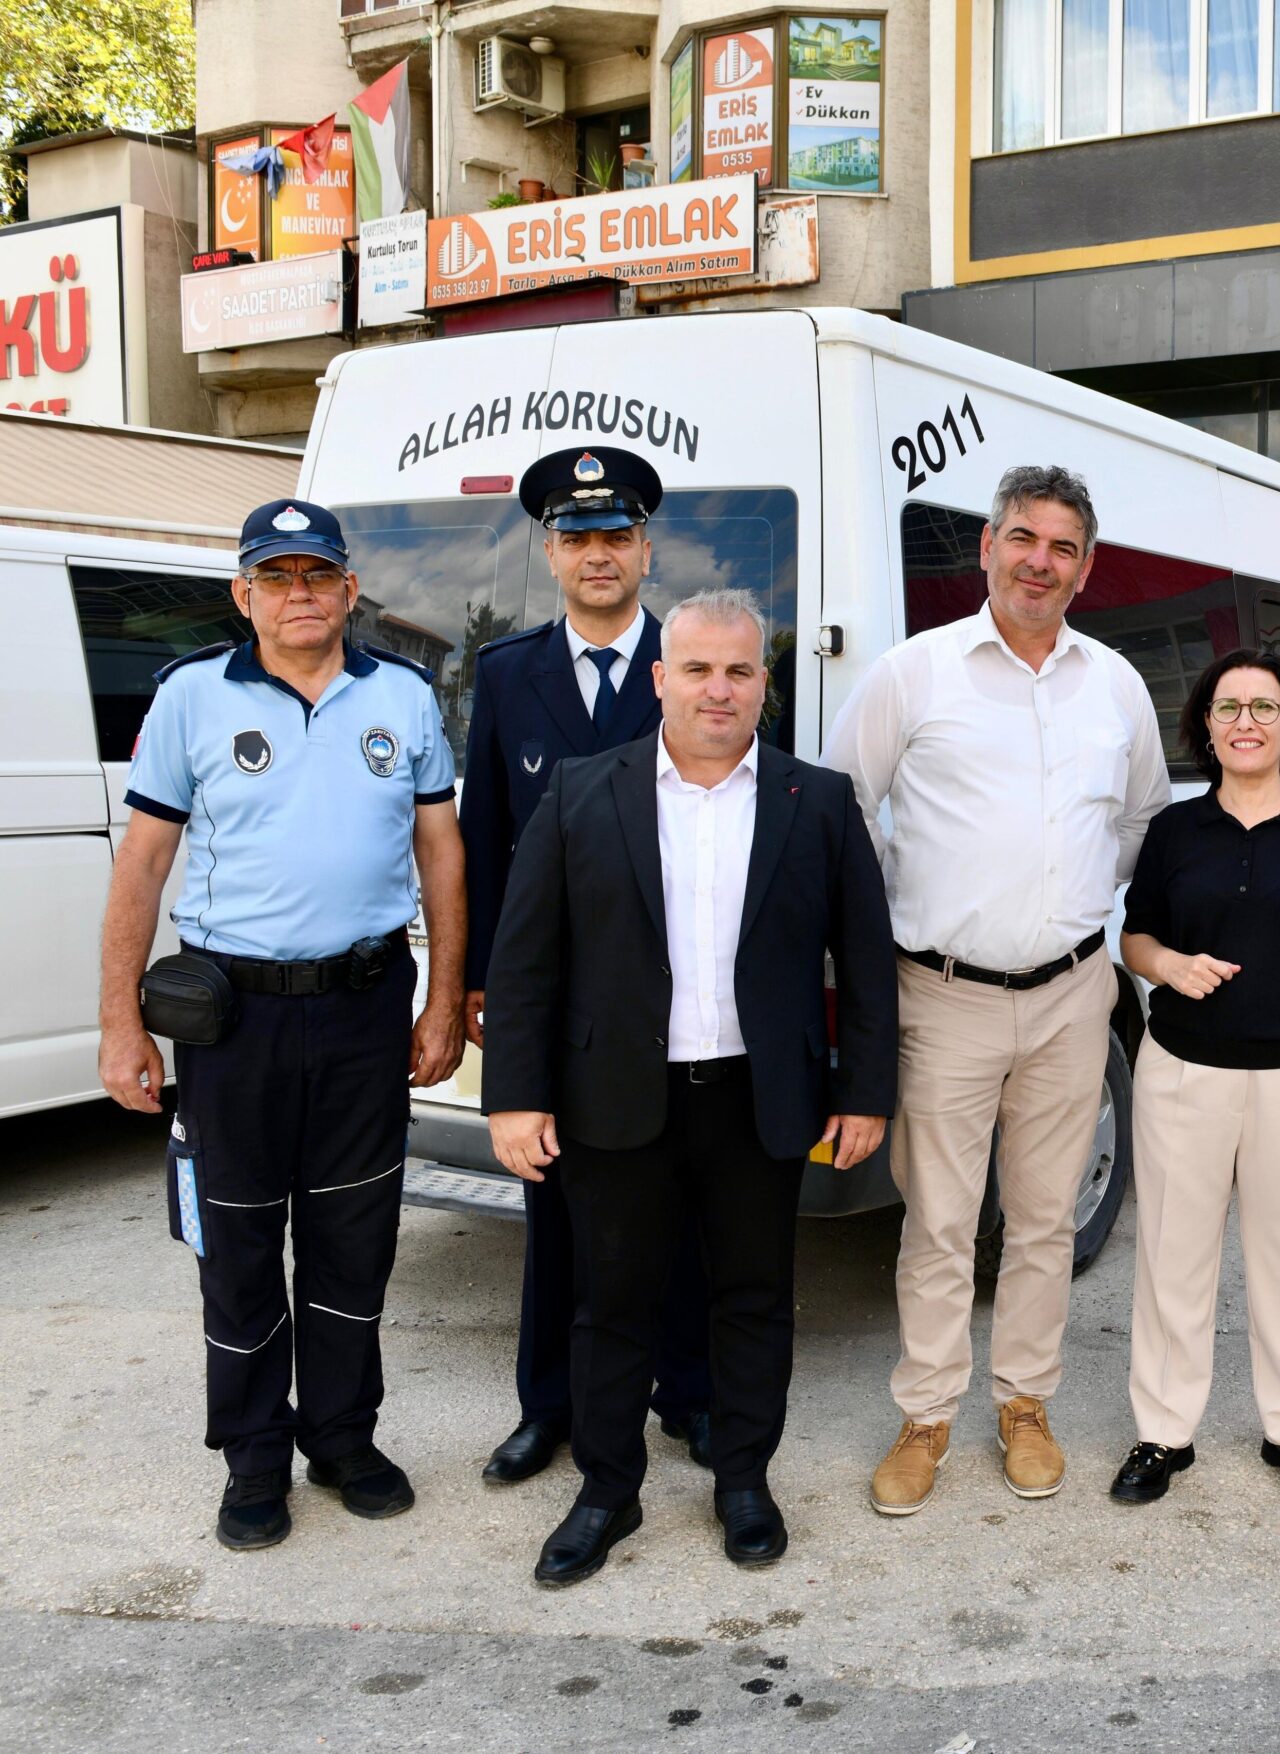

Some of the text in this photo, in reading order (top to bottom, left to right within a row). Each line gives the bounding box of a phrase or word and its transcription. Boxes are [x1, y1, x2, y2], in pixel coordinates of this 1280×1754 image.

[805, 86, 823, 98] Ev
[719, 92, 758, 119] ERİŞ
[805, 105, 870, 120] Dükkan
[707, 122, 769, 149] EMLAK
[722, 151, 753, 168] 0535
[306, 192, 320, 210] VE
[281, 214, 346, 236] MANEVİYAT
[507, 206, 587, 264] ERİŞ
[600, 193, 739, 253] EMLAK
[213, 251, 230, 264] VAR
[367, 239, 418, 259] Kurtuluş Torun
[508, 277, 537, 291] Tarla
[613, 262, 662, 280] Dükkan
[666, 260, 695, 274] Alım
[700, 255, 739, 270] Satım
[432, 279, 490, 299] 0535 358 23 97
[222, 288, 277, 320] SAADET
[398, 390, 700, 473] ALLAH KORUSUN
[890, 392, 986, 494] 2011
